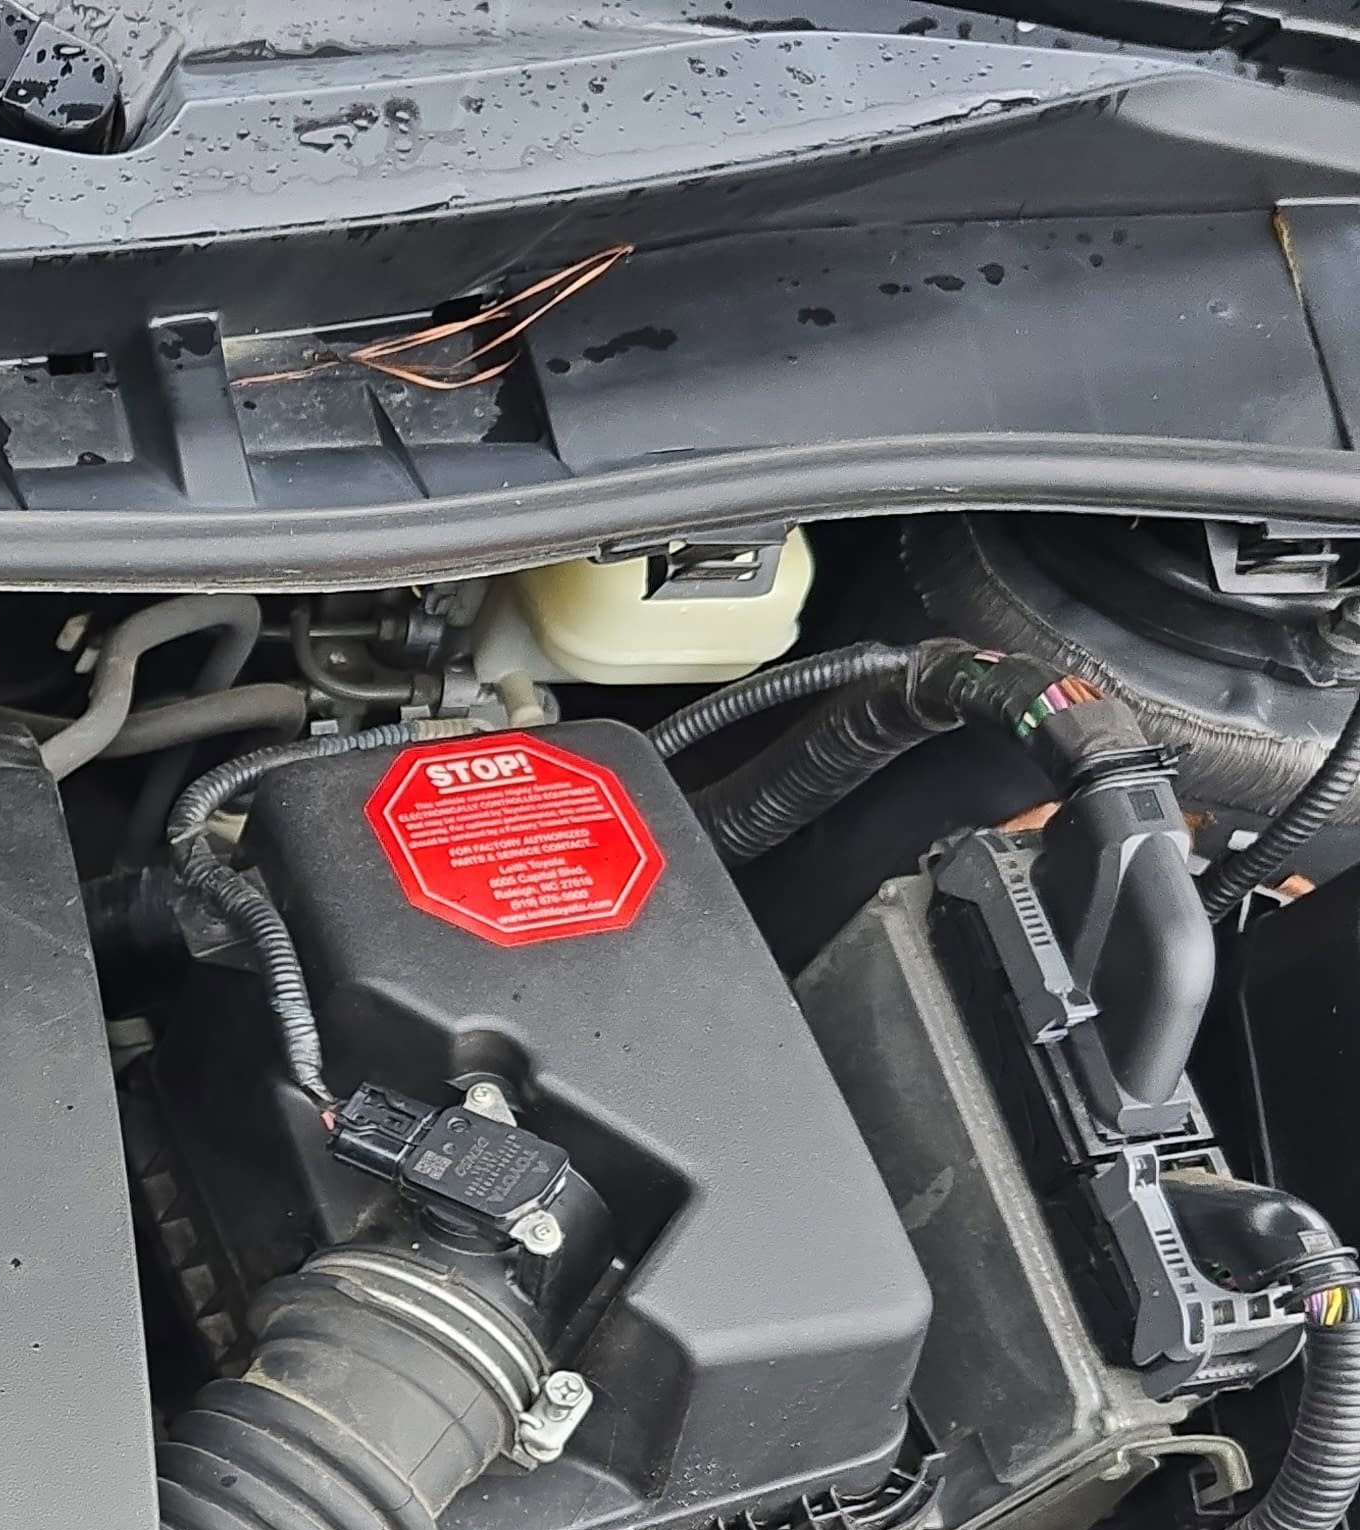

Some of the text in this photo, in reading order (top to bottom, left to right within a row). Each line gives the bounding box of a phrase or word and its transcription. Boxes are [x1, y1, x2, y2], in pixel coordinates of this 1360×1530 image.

[426, 752, 533, 787] STOP!
[473, 838, 522, 853] FACTORY
[523, 828, 590, 846] AUTHORIZED
[450, 854, 486, 868] PARTS
[496, 845, 542, 860] SERVICE
[528, 857, 566, 870] Toyota
[517, 870, 557, 884] Capital
[455, 1136, 489, 1177] DENSO
[486, 1150, 539, 1203] TOYOTA
